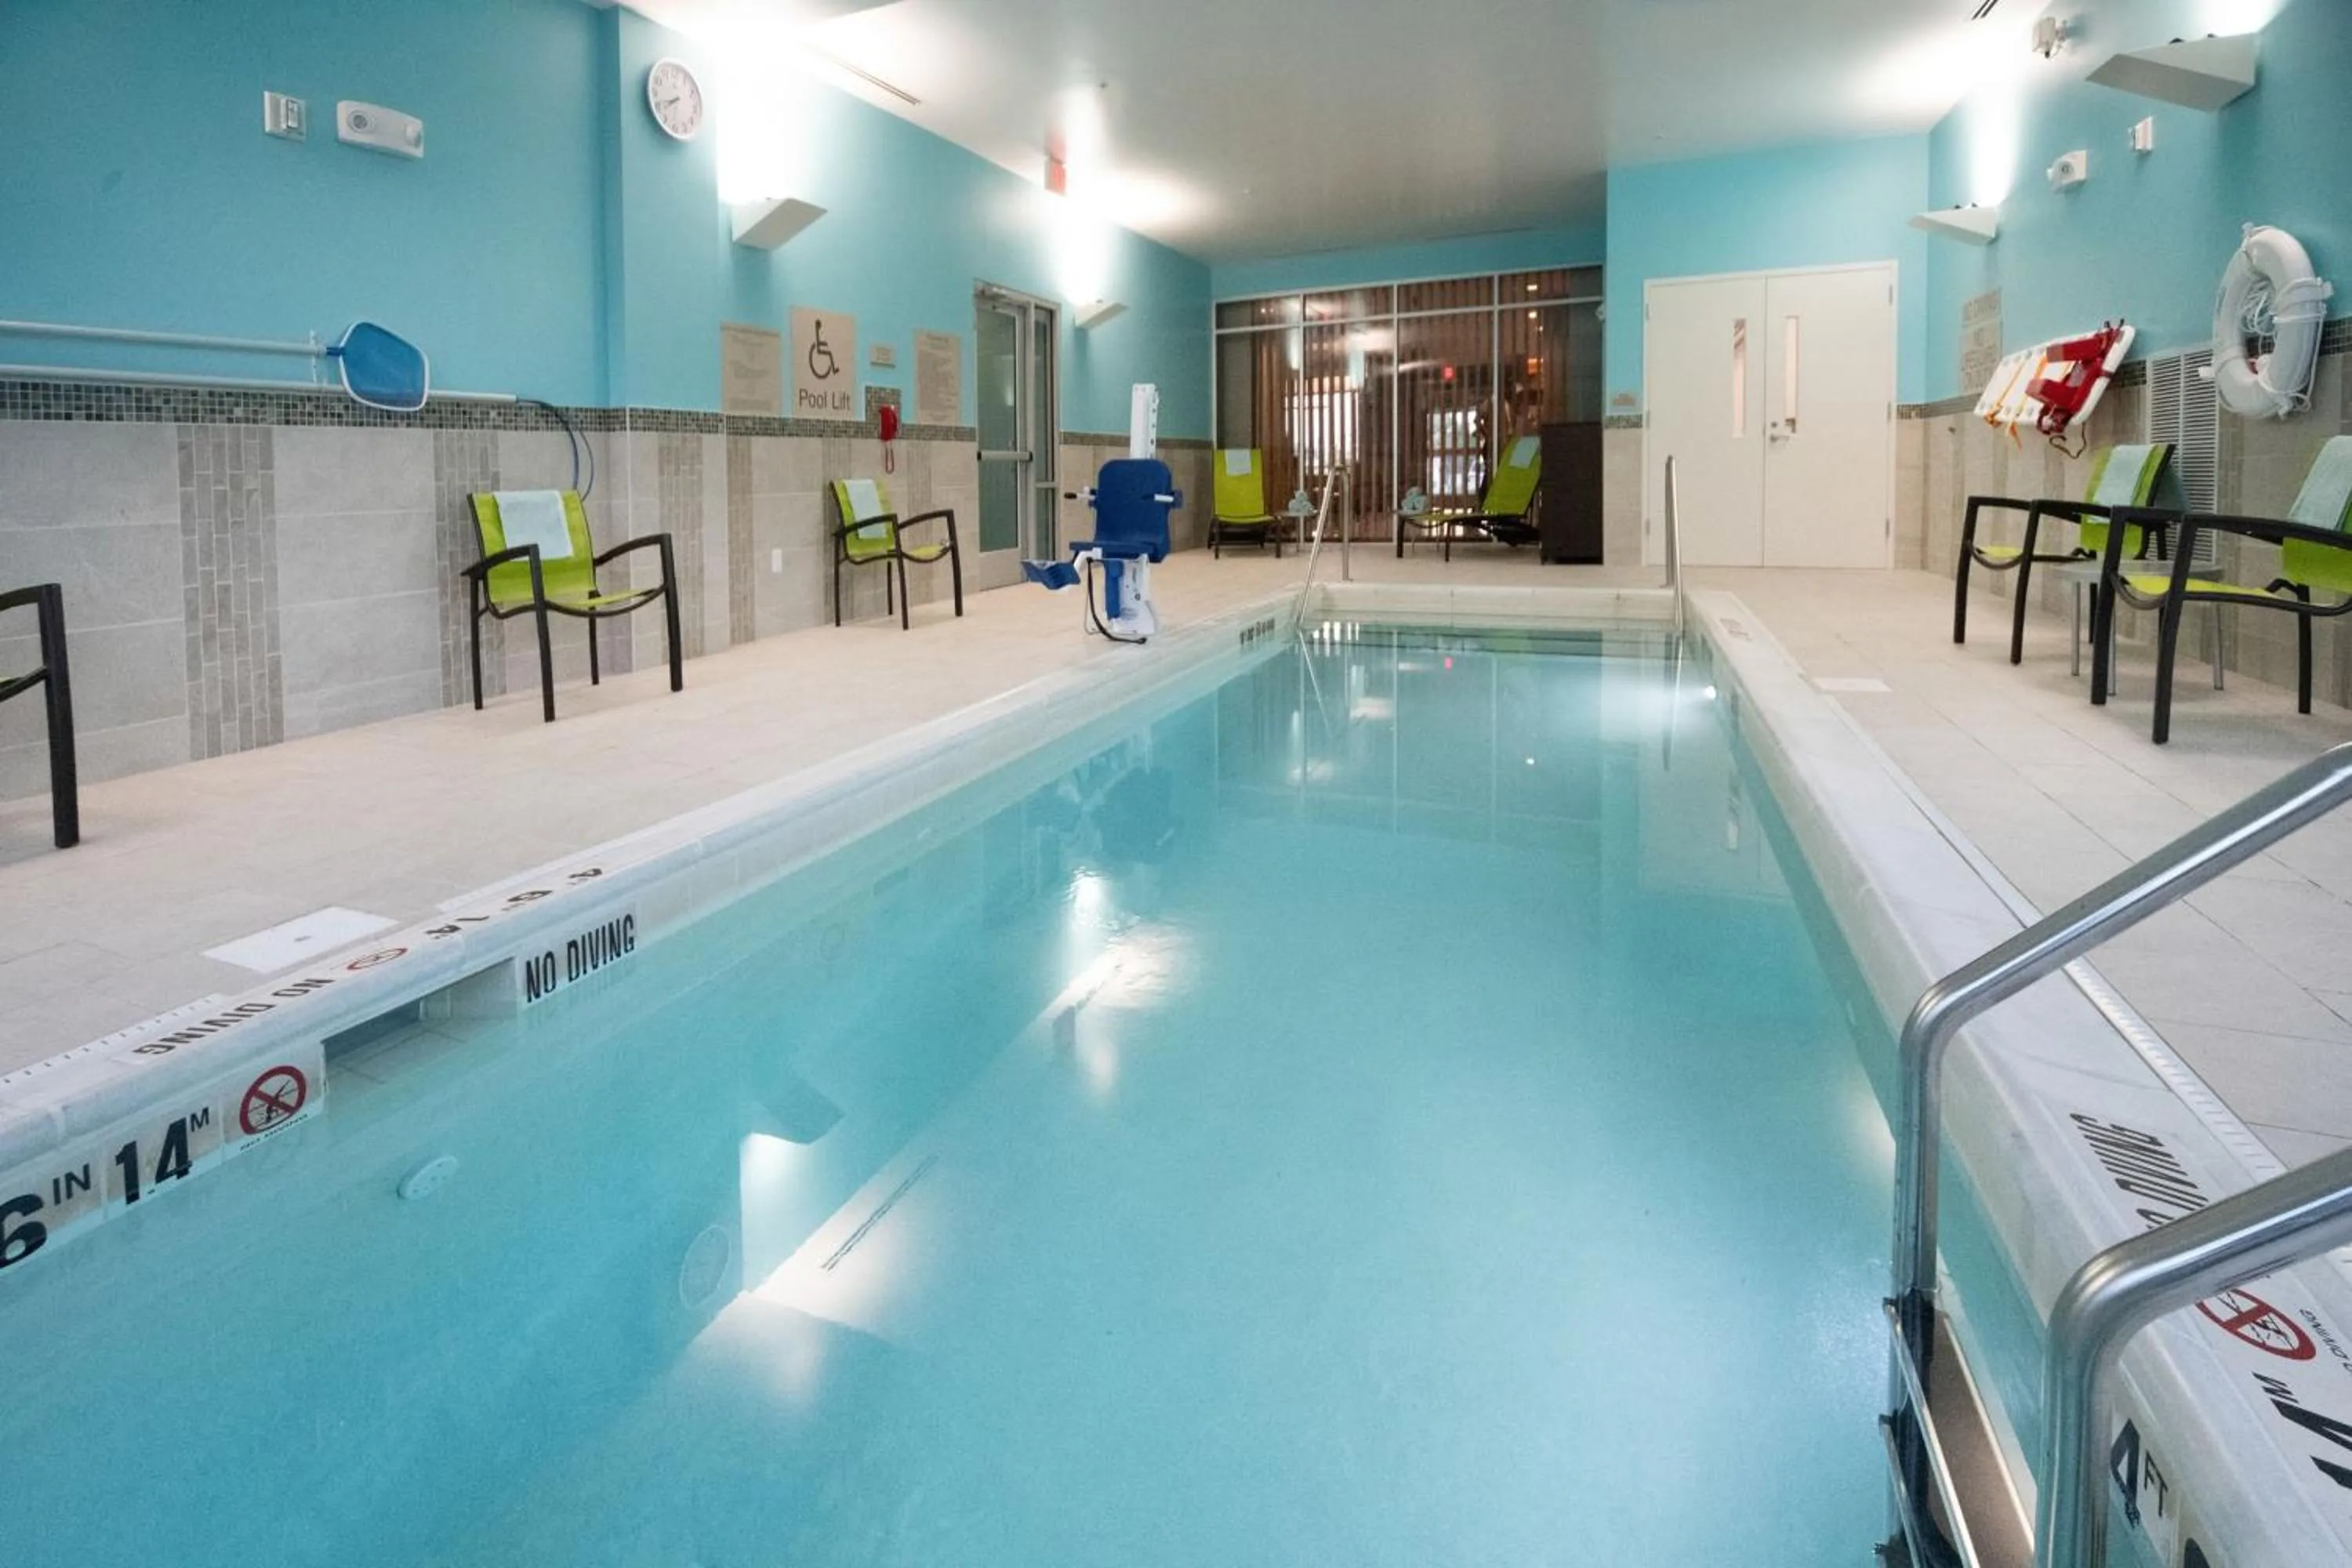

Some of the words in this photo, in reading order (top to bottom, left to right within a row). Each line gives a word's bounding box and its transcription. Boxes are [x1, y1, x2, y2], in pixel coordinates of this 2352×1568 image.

[799, 388, 828, 410] Pool
[832, 390, 851, 412] Lift
[271, 978, 336, 997] NO
[526, 935, 557, 1003] NO
[567, 913, 636, 982] DIVING
[132, 1003, 277, 1054] DIVING
[0, 1193, 48, 1269] 6
[53, 1163, 92, 1207] IN
[190, 1106, 210, 1132] M
[2110, 1418, 2141, 1529] 4
[2144, 1449, 2169, 1519] FT
